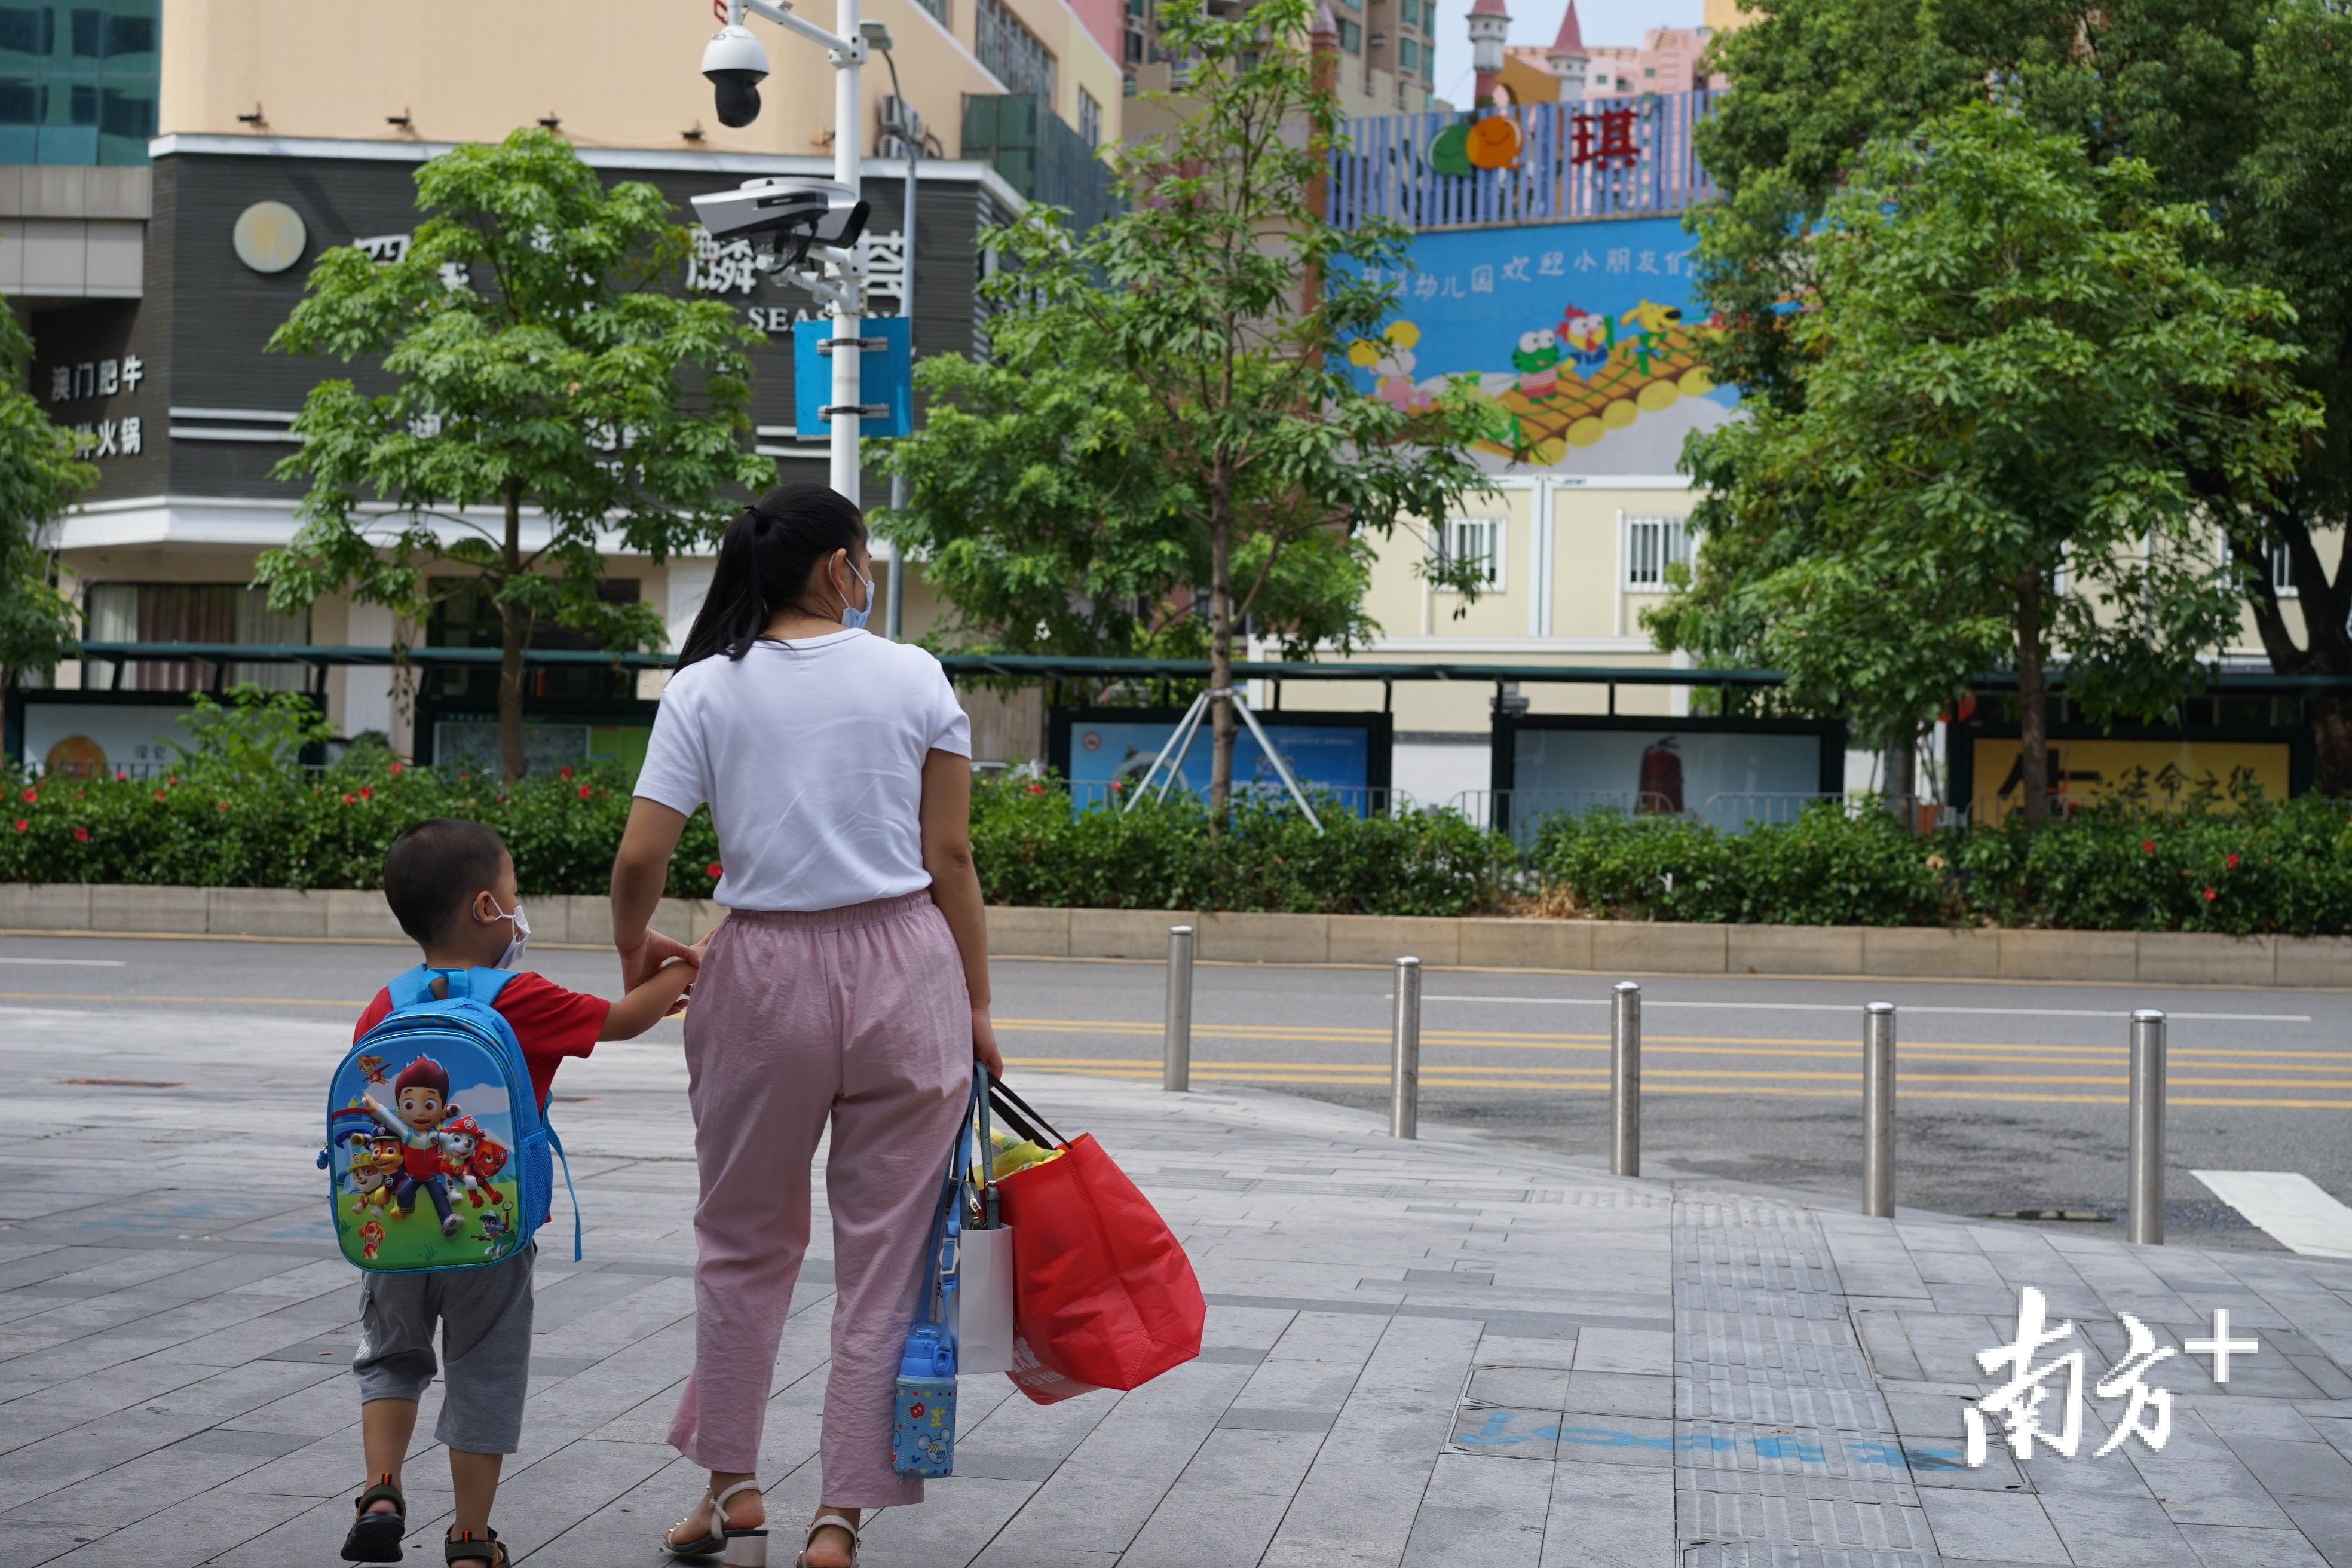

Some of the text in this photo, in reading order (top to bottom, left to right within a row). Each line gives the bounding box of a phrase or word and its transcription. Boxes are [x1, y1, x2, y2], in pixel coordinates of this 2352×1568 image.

[1571, 108, 1640, 170] 琪
[52, 354, 142, 402] 澳门肥牛
